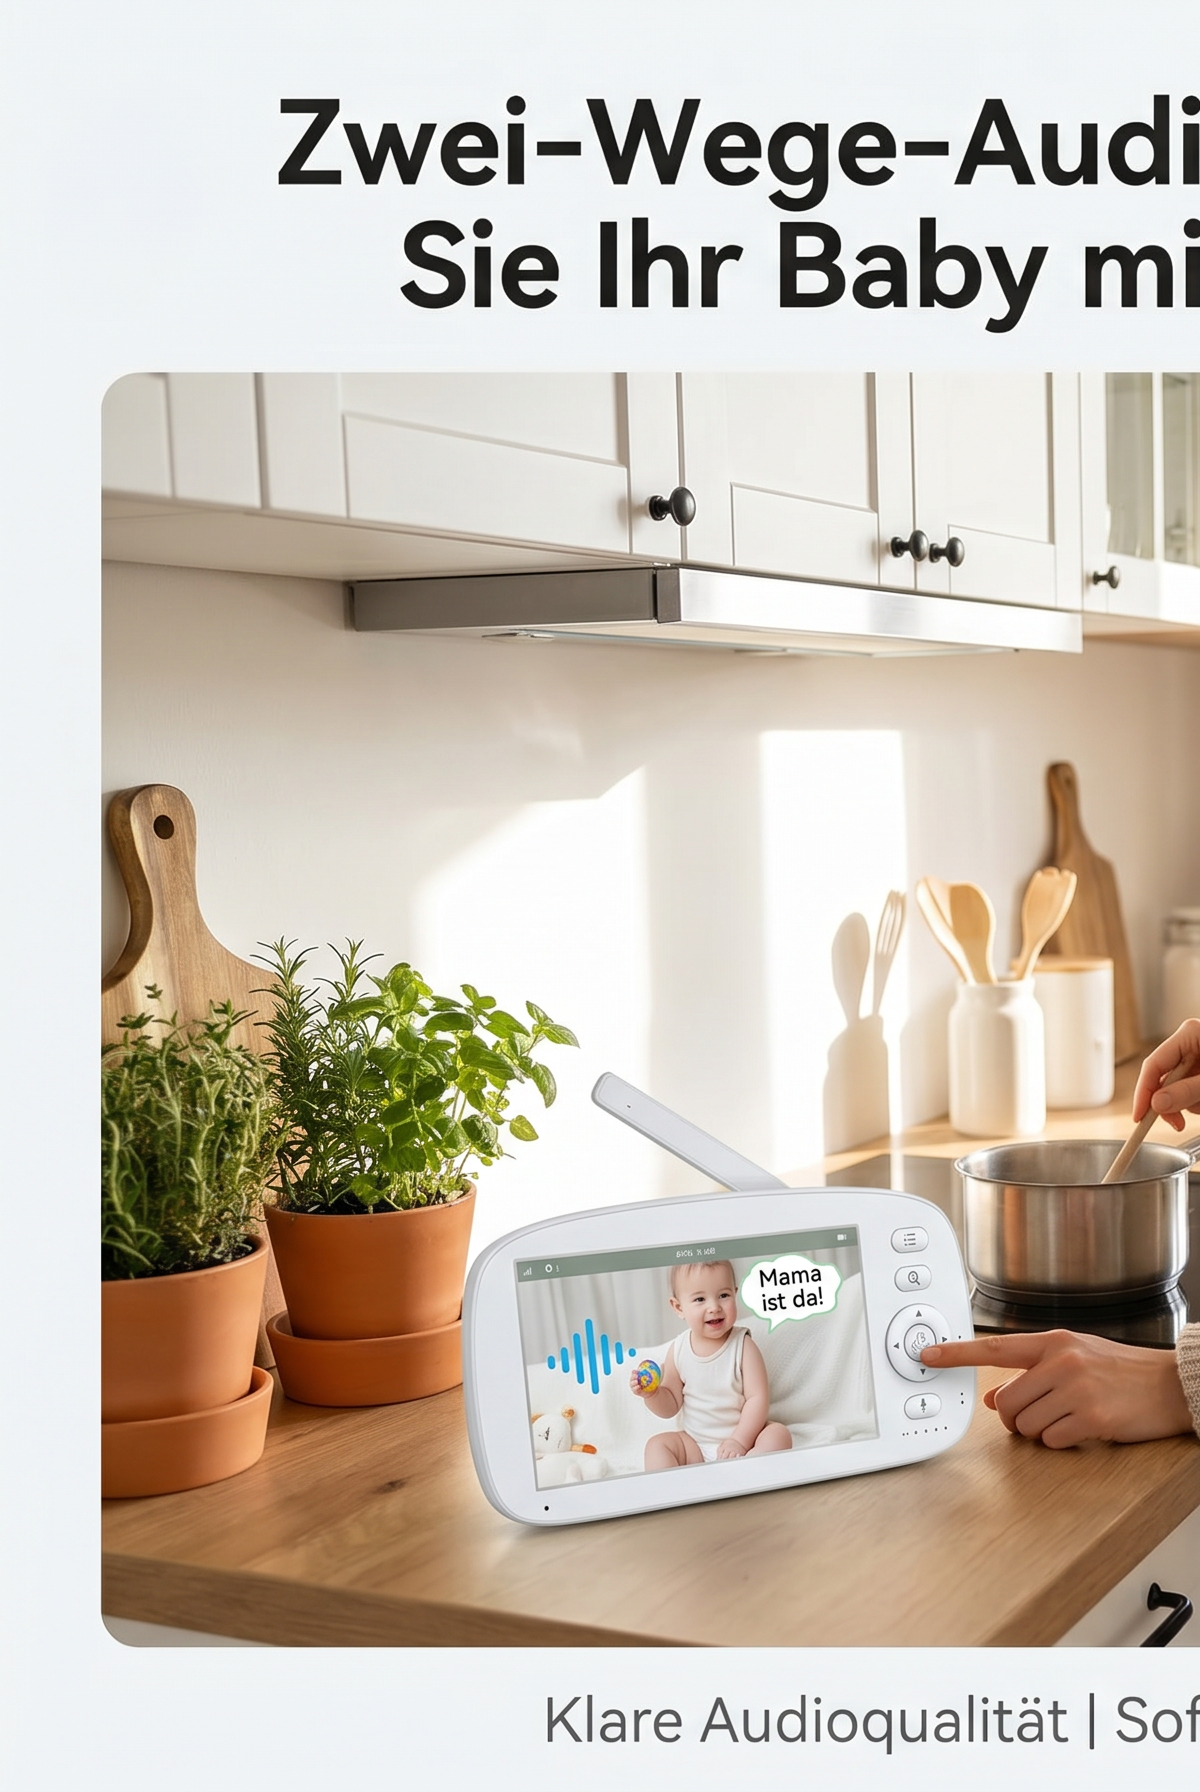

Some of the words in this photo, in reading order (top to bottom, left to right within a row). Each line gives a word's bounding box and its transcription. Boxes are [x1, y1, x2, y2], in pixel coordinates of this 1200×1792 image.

[759, 1268, 822, 1288] Mama
[762, 1293, 787, 1311] ist
[792, 1286, 824, 1308] da!
